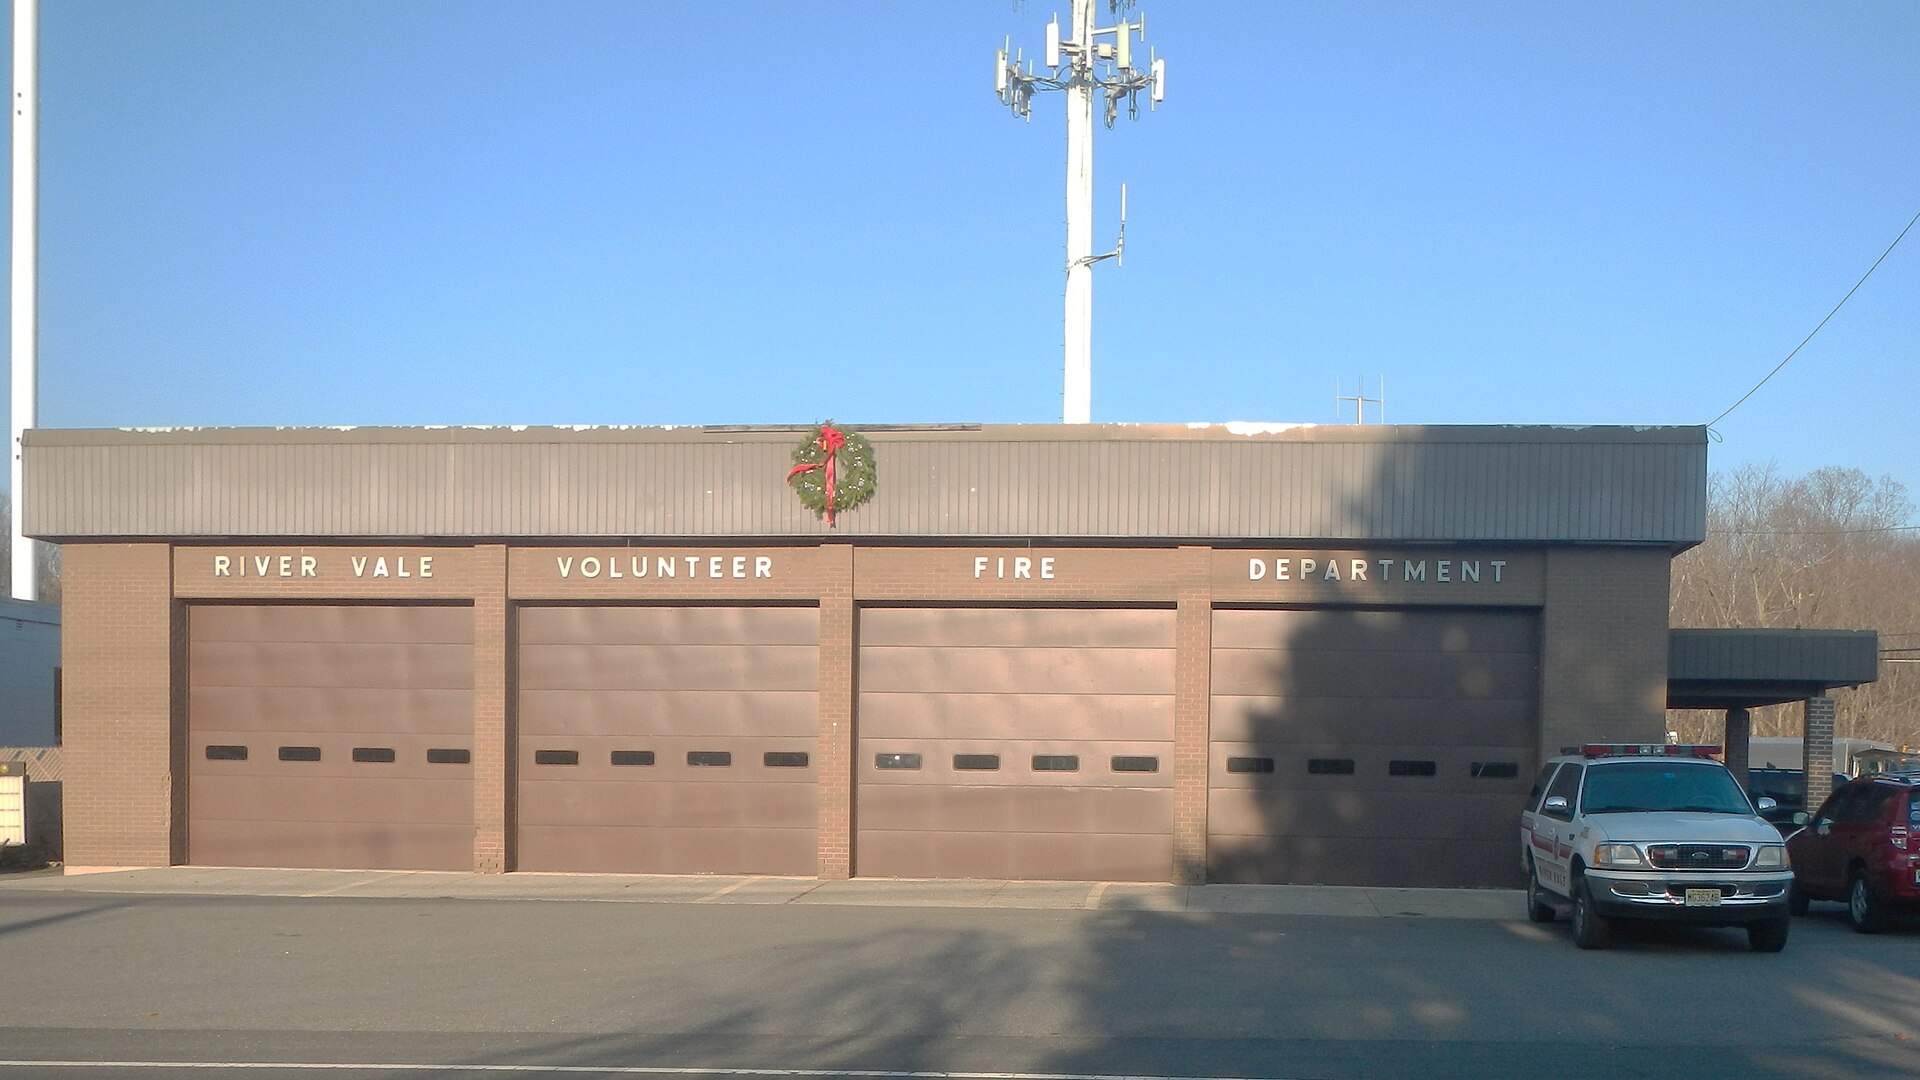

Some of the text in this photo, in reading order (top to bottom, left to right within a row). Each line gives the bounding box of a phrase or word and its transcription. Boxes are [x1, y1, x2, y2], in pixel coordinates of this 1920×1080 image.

[214, 555, 1507, 582] RIVER VALE VOLUNTEER FIRE DEPARTMENT
